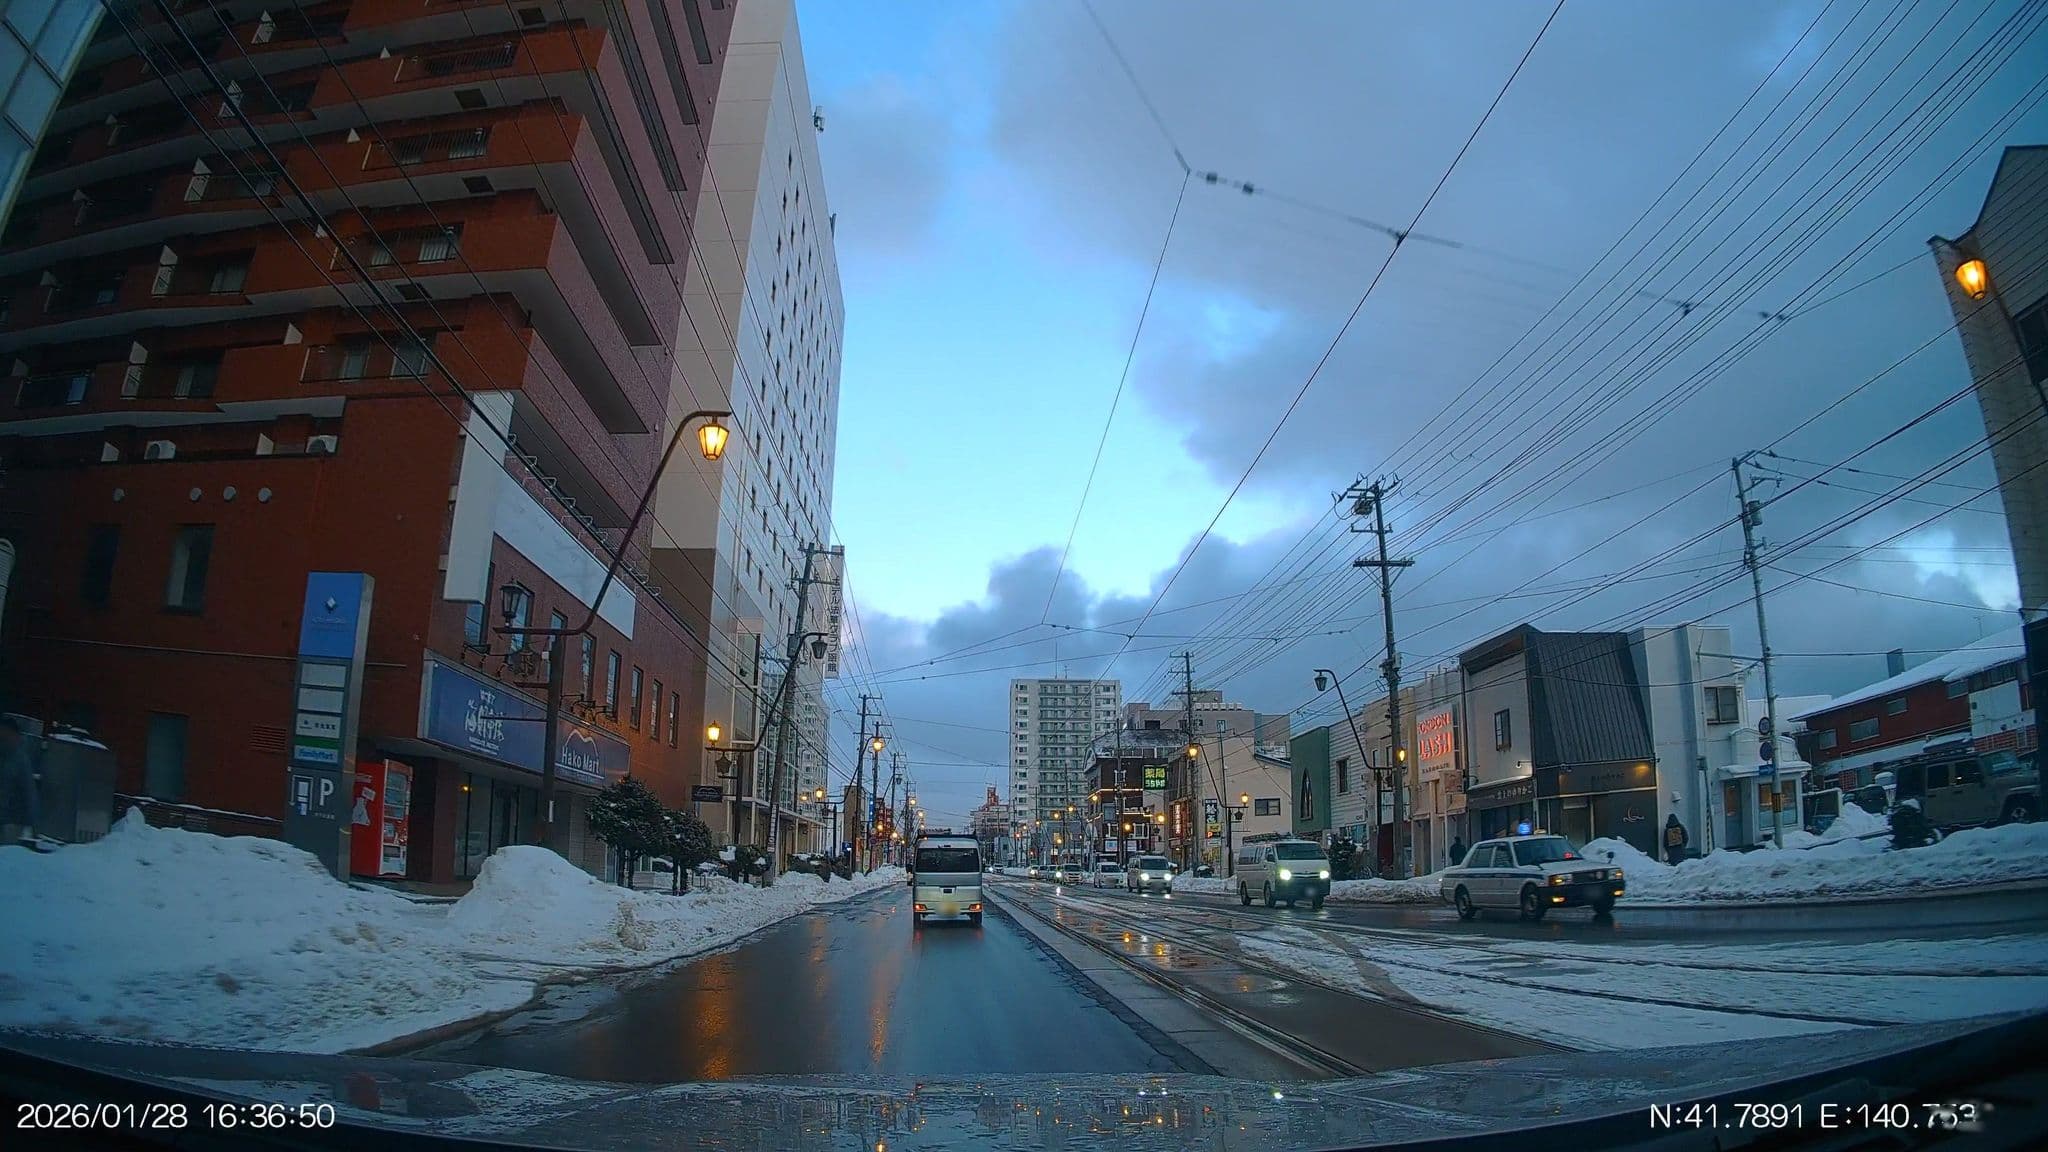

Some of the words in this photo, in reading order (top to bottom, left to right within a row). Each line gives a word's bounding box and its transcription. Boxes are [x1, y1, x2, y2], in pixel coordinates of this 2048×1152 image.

[561, 746, 583, 769] Hako
[584, 753, 601, 775] Mart
[320, 778, 334, 807] P
